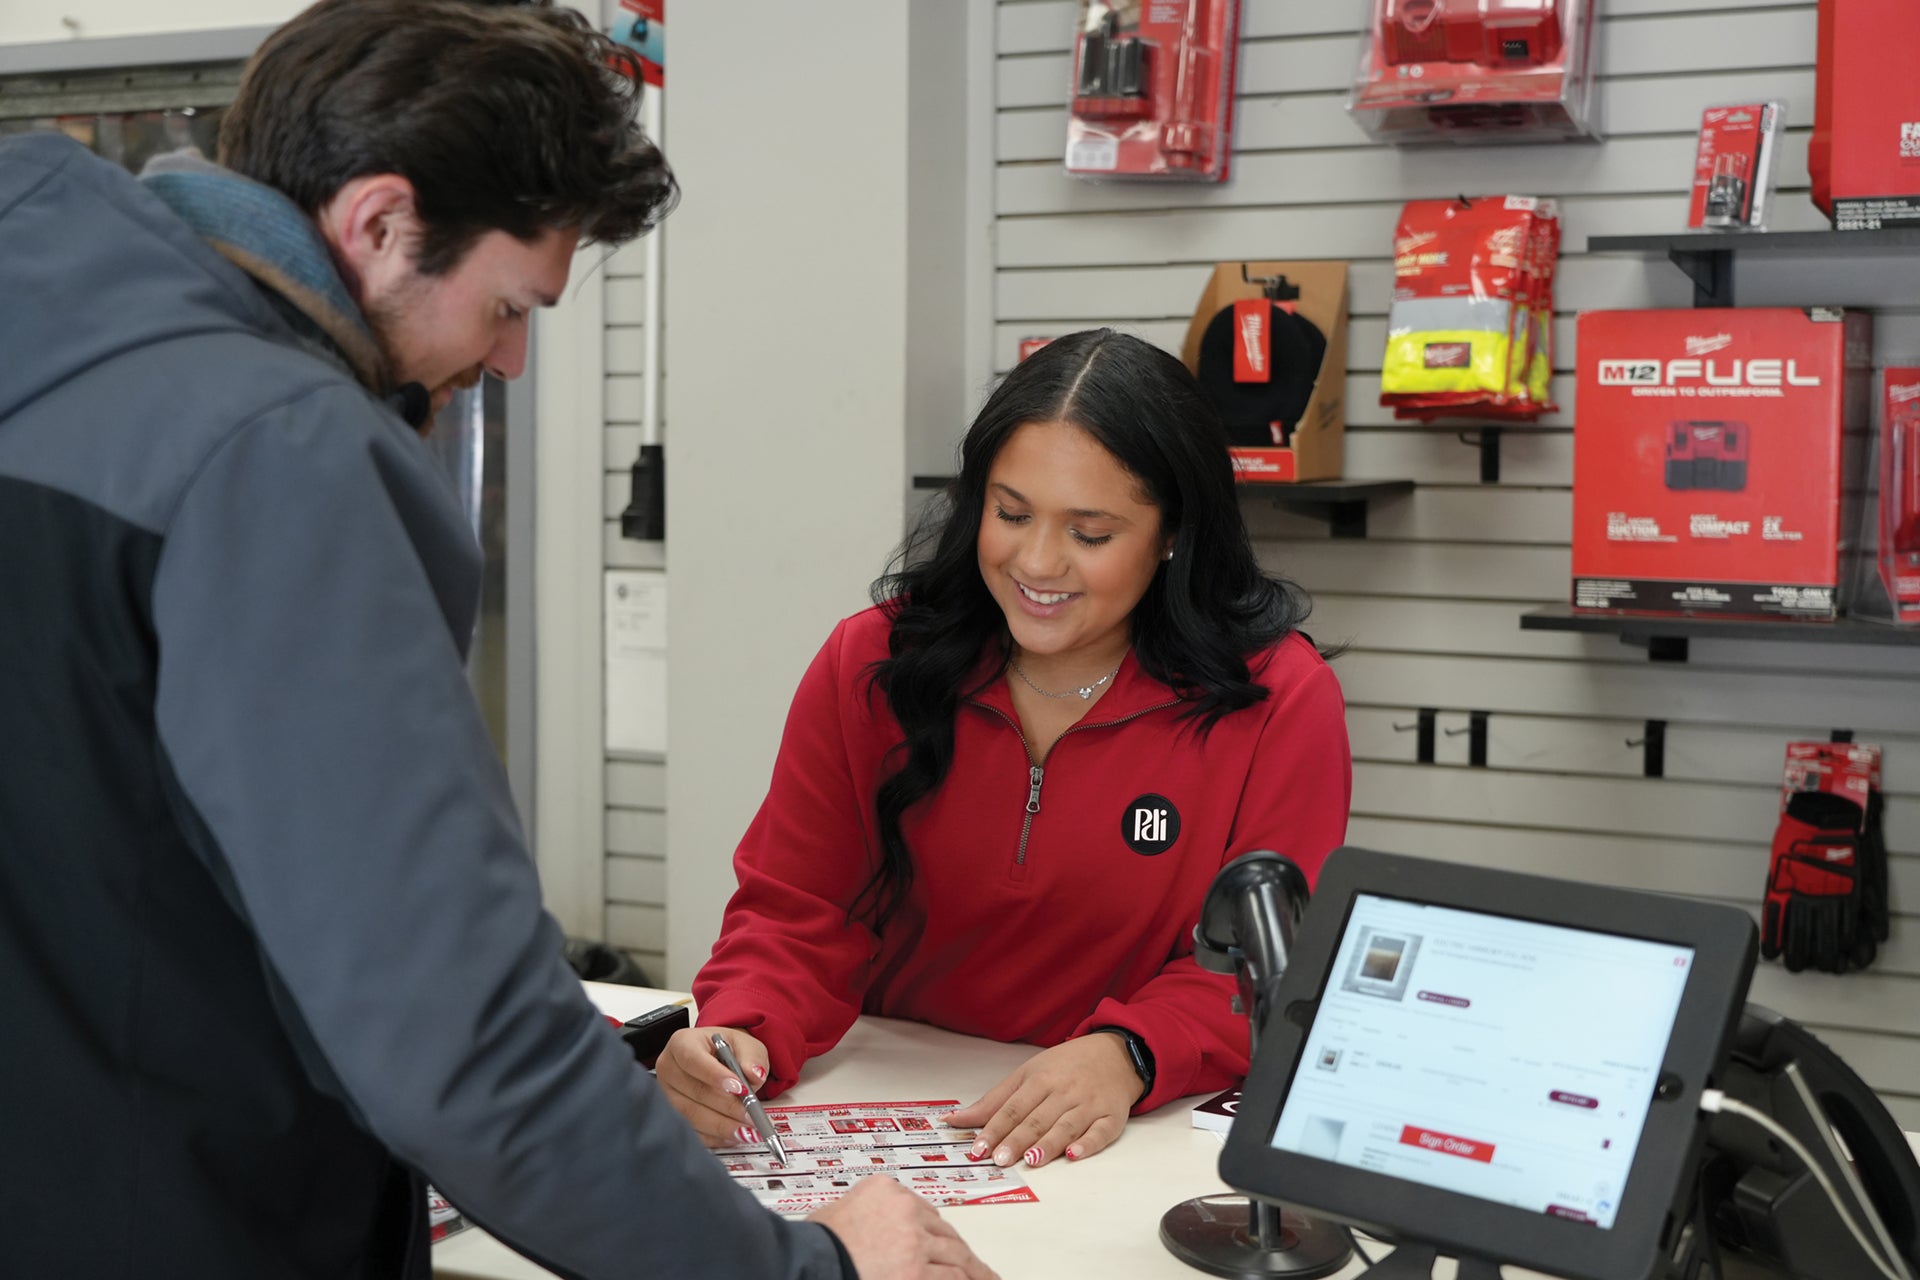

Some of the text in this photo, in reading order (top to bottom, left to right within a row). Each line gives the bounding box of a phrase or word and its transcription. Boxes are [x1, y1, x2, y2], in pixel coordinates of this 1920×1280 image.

[1602, 359, 1820, 386] M12 FUEL
[1632, 387, 1677, 397] DRIVEN
[1679, 387, 1696, 397] TO
[1607, 524, 1660, 537] SUCTION
[1690, 522, 1750, 535] COMPACT
[1134, 808, 1167, 841] Pdi
[1420, 1132, 1476, 1154] Sign Order
